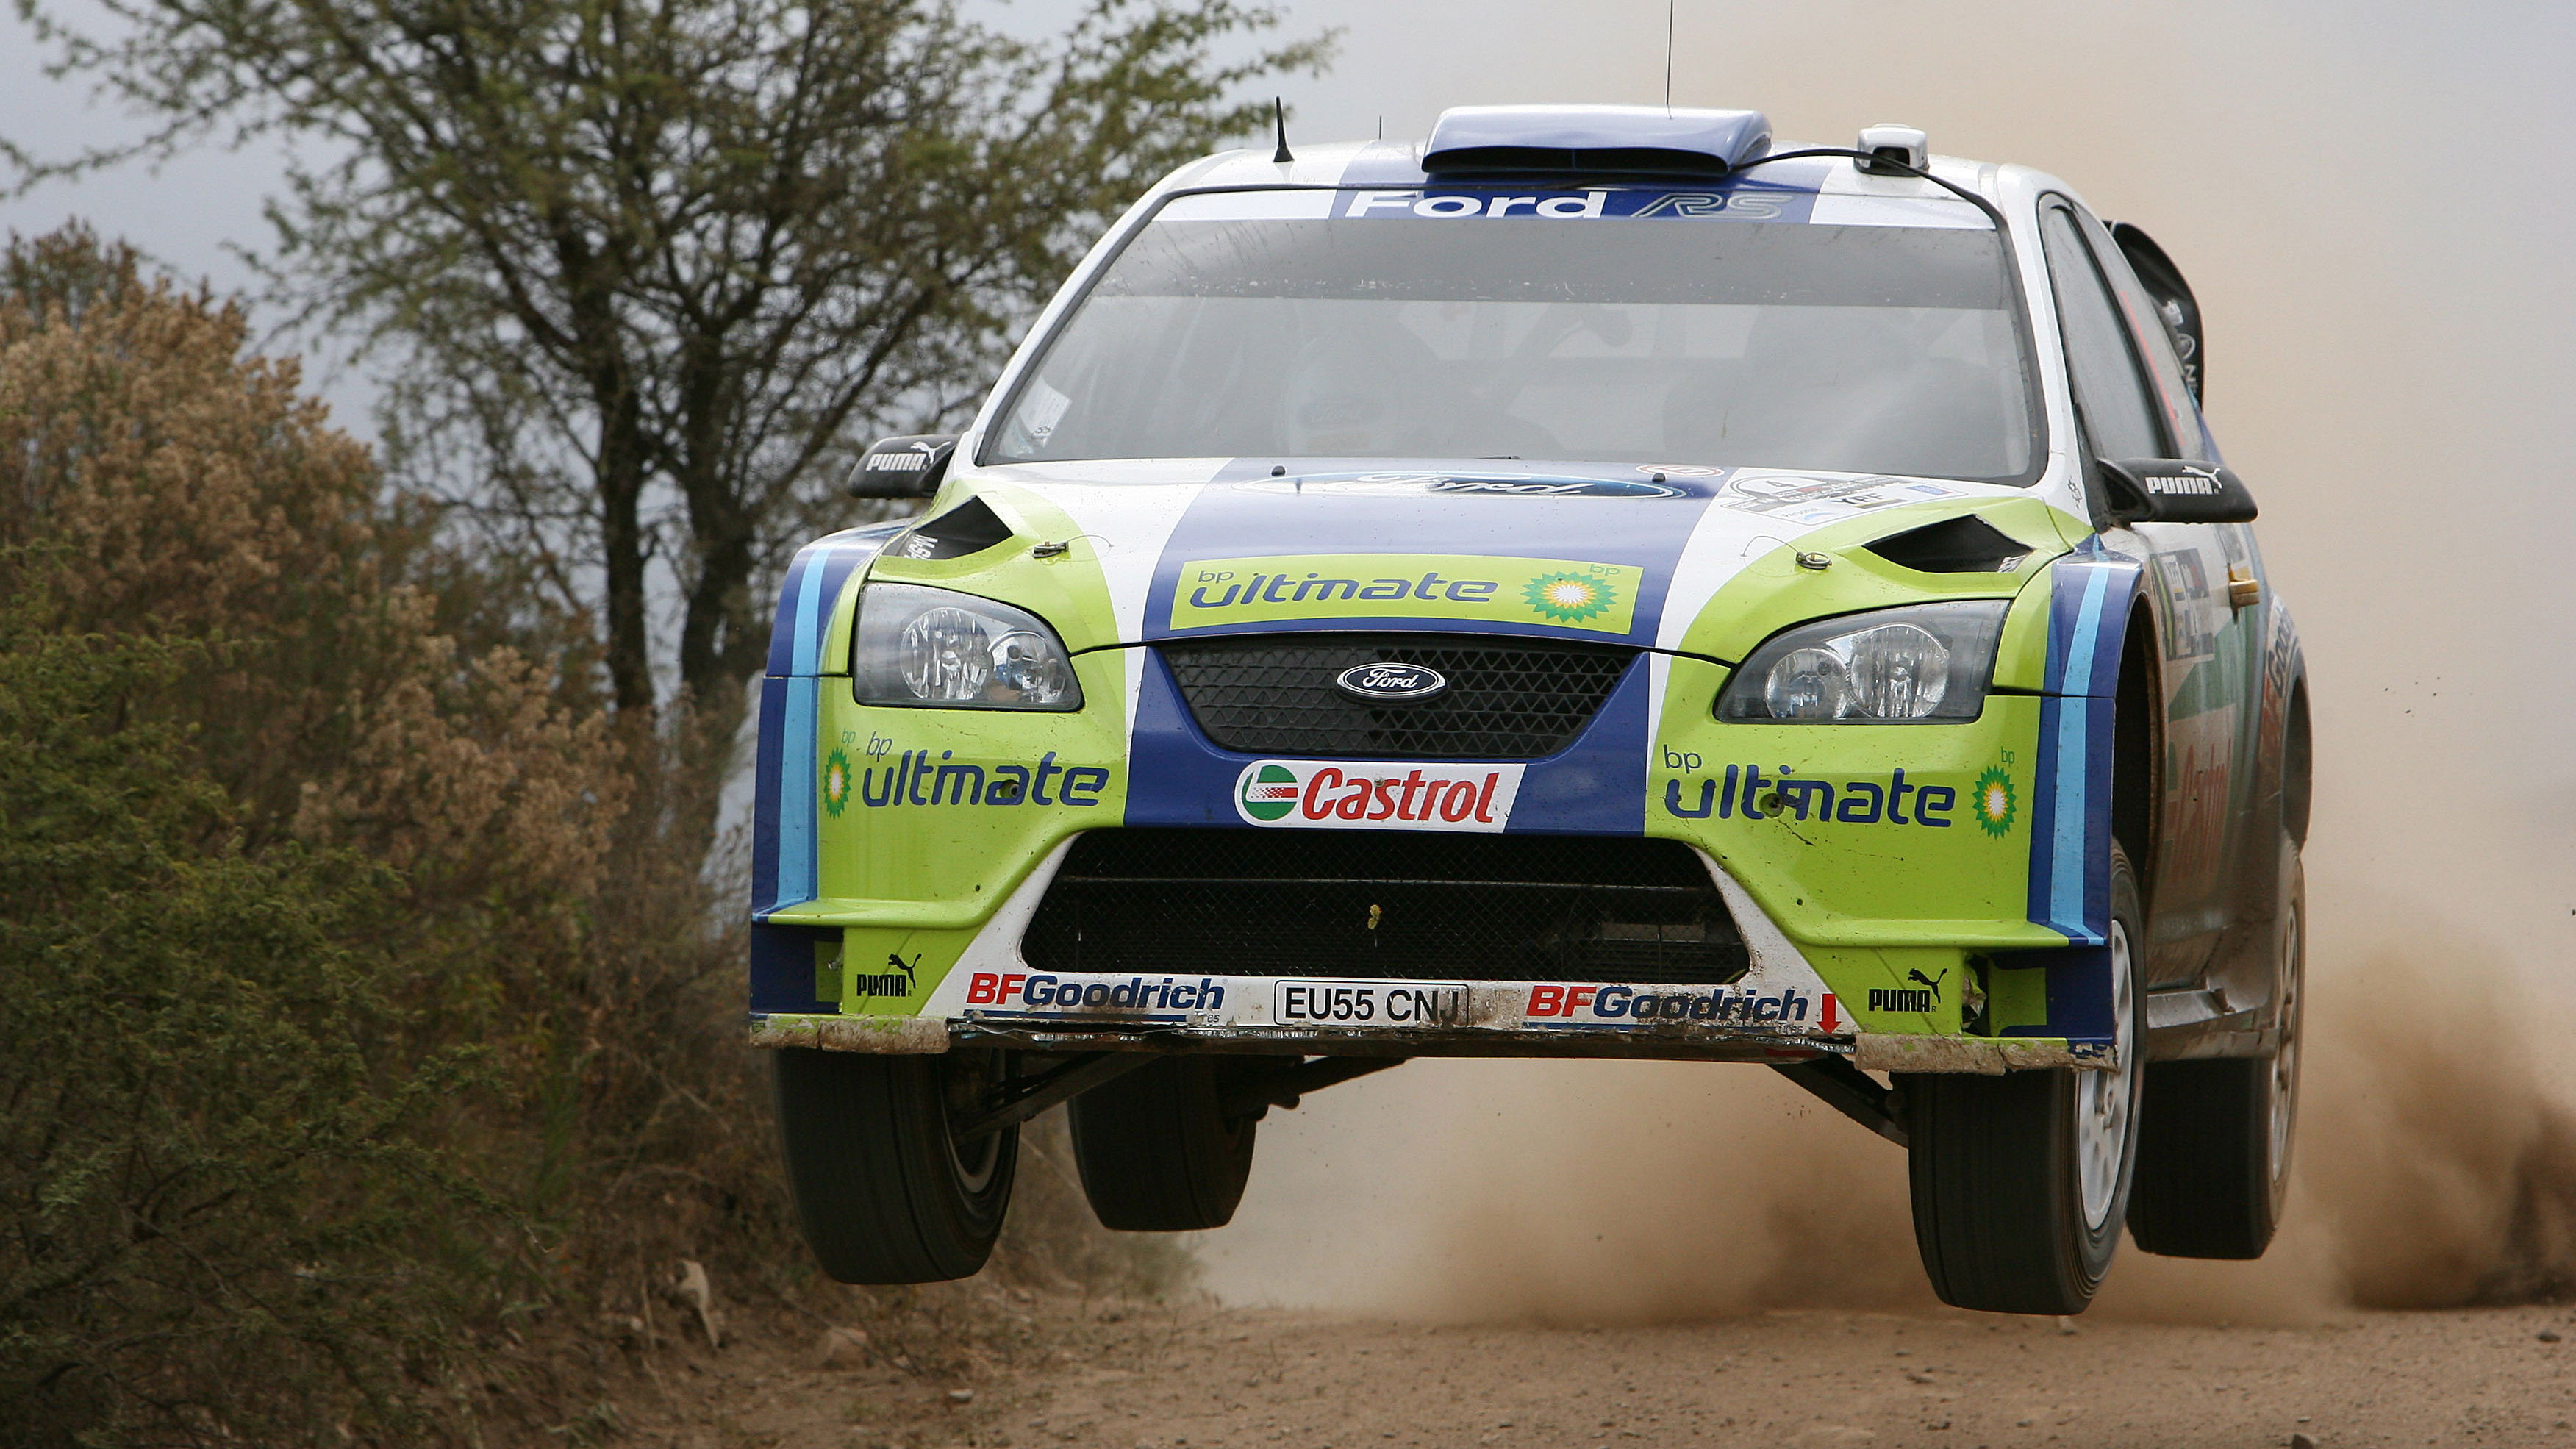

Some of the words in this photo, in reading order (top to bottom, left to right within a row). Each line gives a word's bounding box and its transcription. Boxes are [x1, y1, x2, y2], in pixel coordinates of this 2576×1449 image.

[1345, 190, 1607, 219] Ford
[1628, 192, 1798, 220] RS
[866, 453, 928, 472] PUMA
[1334, 472, 1595, 496] Ford
[2145, 476, 2214, 495] PUMA
[1830, 493, 1888, 506] YPF
[1198, 570, 1235, 585] bp
[1589, 563, 1621, 576] bp
[1189, 572, 1498, 609] ultimate
[1362, 668, 1420, 691] Ford
[841, 729, 856, 744] bp
[866, 731, 892, 762] bp
[1664, 743, 1703, 774] bp
[2000, 746, 2016, 768] bp
[862, 750, 1110, 807] ultimate
[1302, 767, 1500, 823] Castrol
[1664, 764, 1956, 828] ultimate
[856, 973, 907, 997] PUMA
[966, 972, 1226, 1010] BFGoodrich
[1285, 987, 1375, 1021] EU55
[1525, 984, 1811, 1021] BFGoodrich
[1868, 988, 1931, 1012] PUMA
